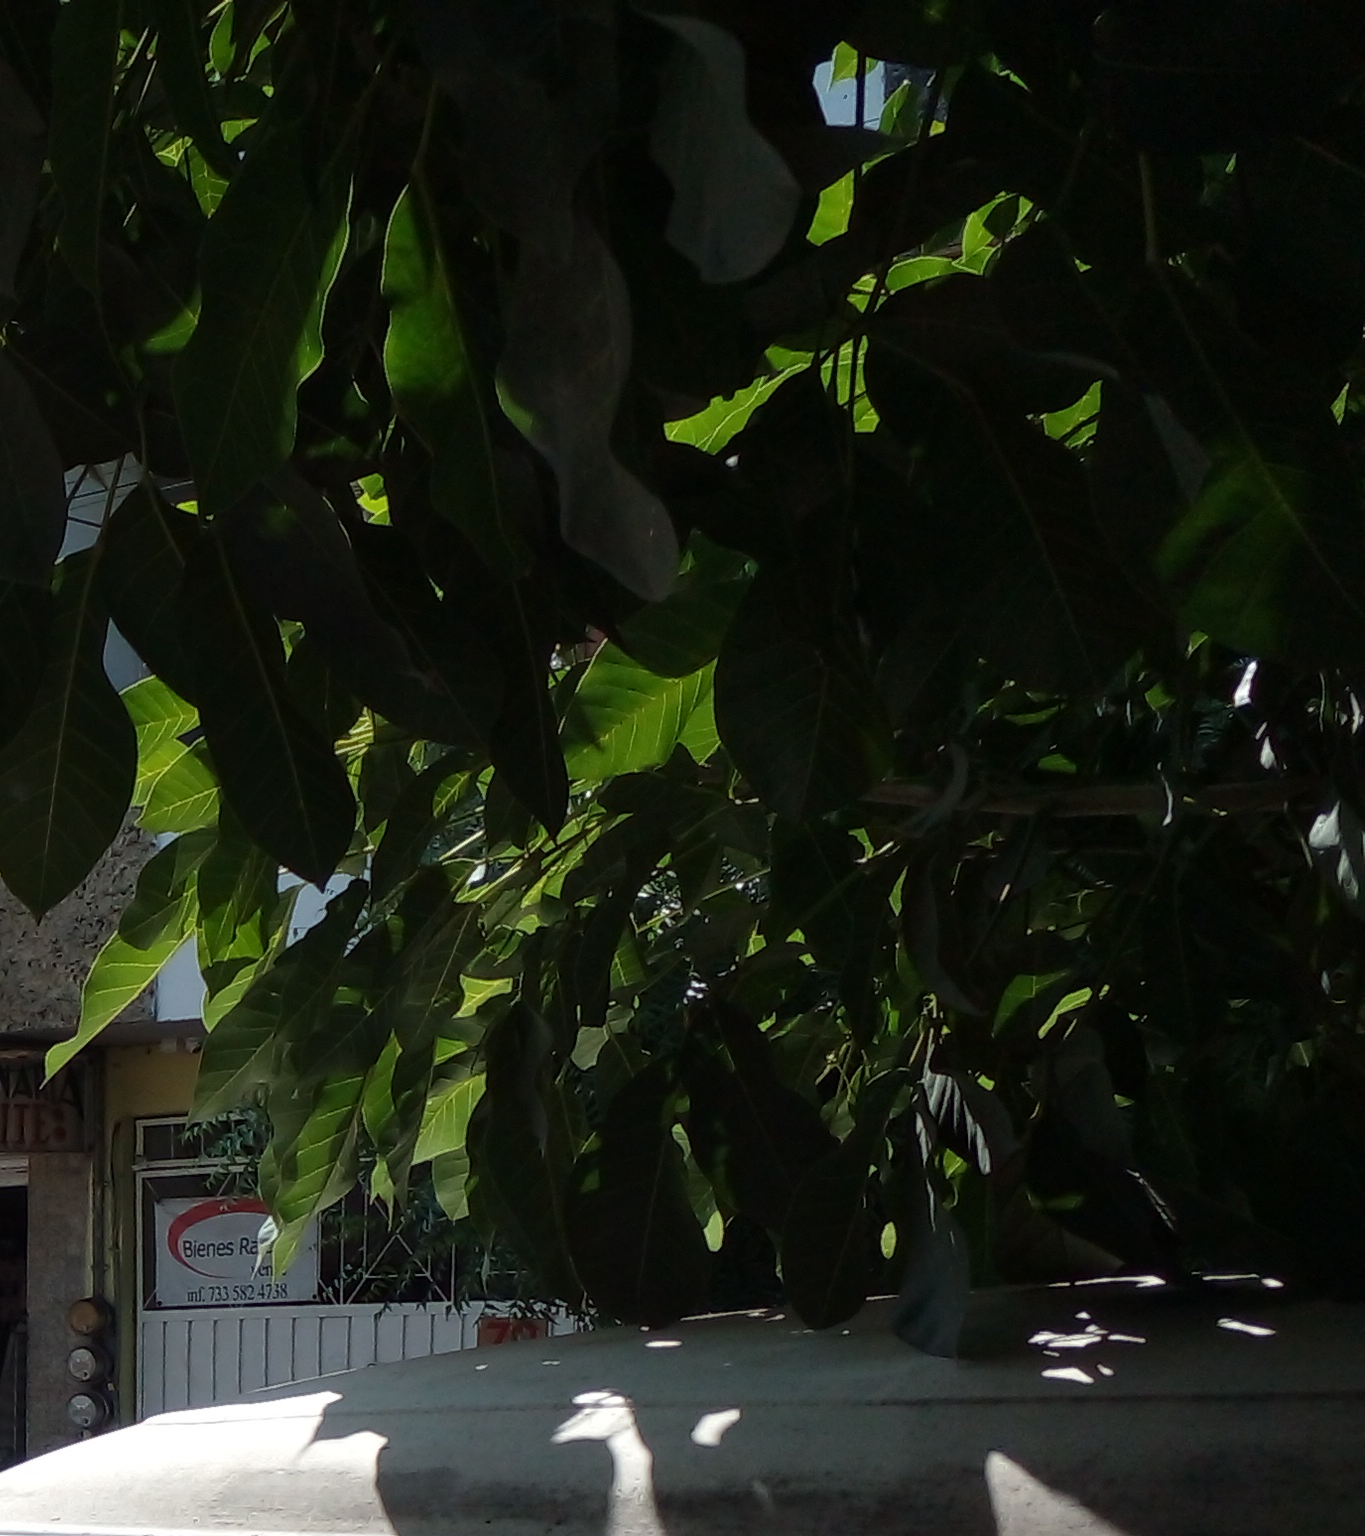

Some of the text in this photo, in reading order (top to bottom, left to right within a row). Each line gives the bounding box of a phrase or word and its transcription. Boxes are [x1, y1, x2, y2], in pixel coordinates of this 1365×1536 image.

[183, 1240, 234, 1258] Bienes
[208, 1286, 230, 1302] 733
[232, 1284, 255, 1301] 582
[257, 1282, 288, 1300] 4738
